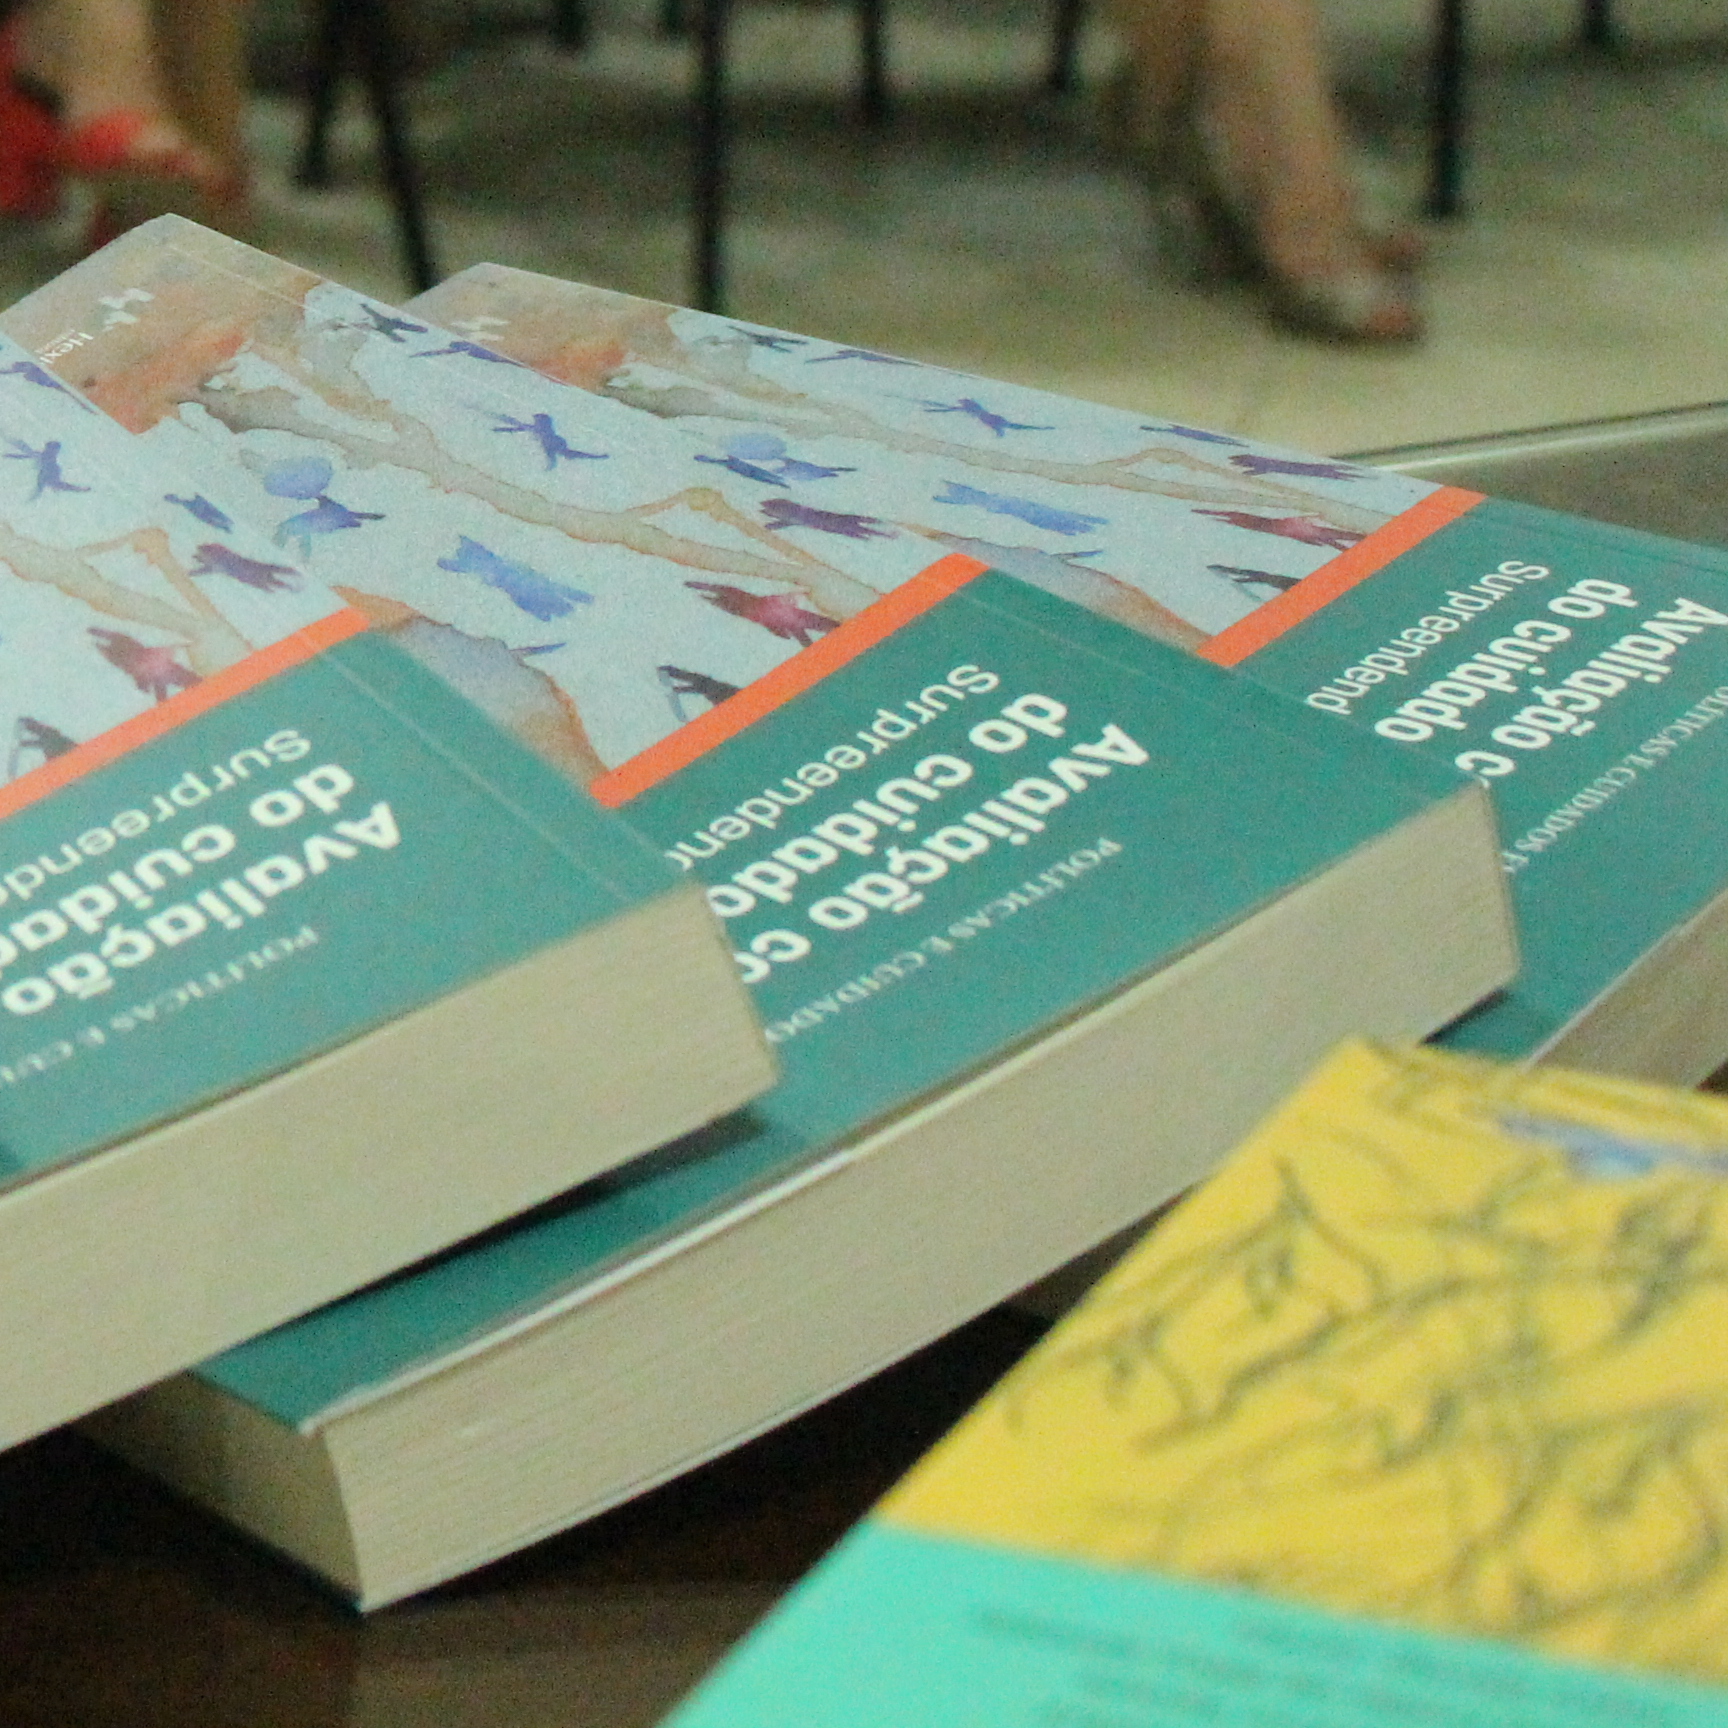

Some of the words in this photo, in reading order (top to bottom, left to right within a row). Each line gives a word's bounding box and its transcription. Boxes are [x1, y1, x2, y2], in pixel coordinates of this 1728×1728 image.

[1547, 578, 1638, 619] do
[967, 692, 1068, 755] do
[1373, 619, 1572, 743] cuidado
[1490, 596, 1728, 751] Avaliação
[248, 763, 355, 827] do
[705, 753, 974, 918] cuidado
[807, 723, 1150, 931] Avaliação
[0, 801, 402, 1017] Avaliação
